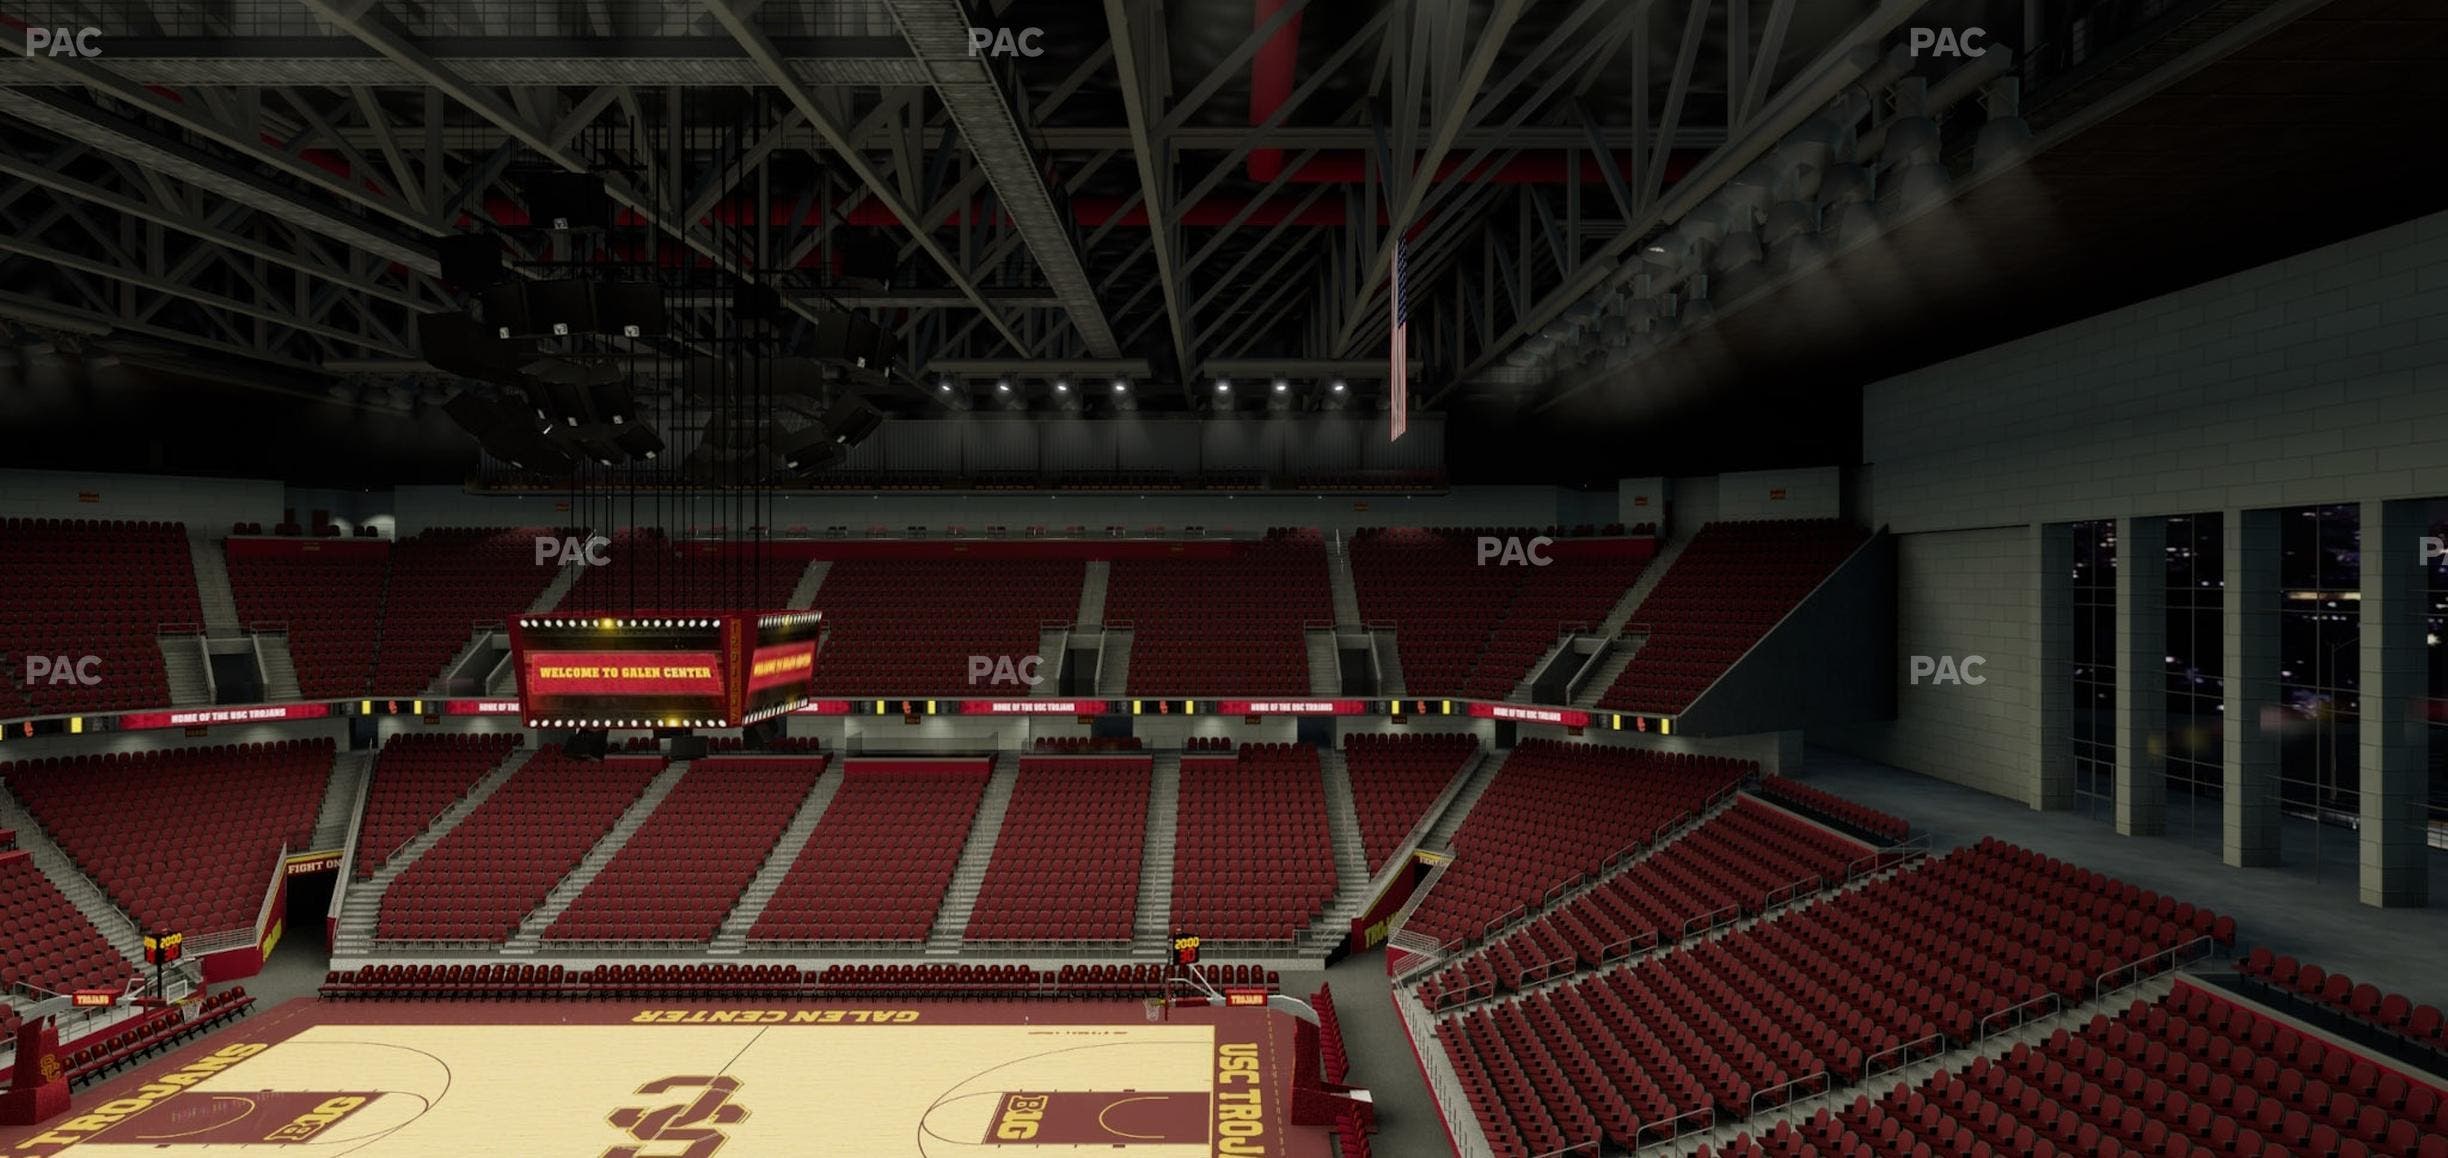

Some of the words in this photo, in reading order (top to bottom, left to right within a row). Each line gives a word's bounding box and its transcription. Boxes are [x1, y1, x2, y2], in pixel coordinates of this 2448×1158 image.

[540, 667, 599, 679] WELCOME
[602, 667, 619, 678] TO
[621, 667, 661, 679] GALEN
[663, 667, 711, 679] CENTER
[249, 708, 286, 718] TROJANS
[288, 861, 323, 874] FIGHT
[326, 859, 343, 869] ON
[631, 1010, 788, 1023] CENTER
[790, 1010, 920, 1023] GALEN
[1219, 1042, 1260, 1084] USC
[15, 1042, 269, 1149] TROJANS
[1219, 1088, 1265, 1158] TROJ
